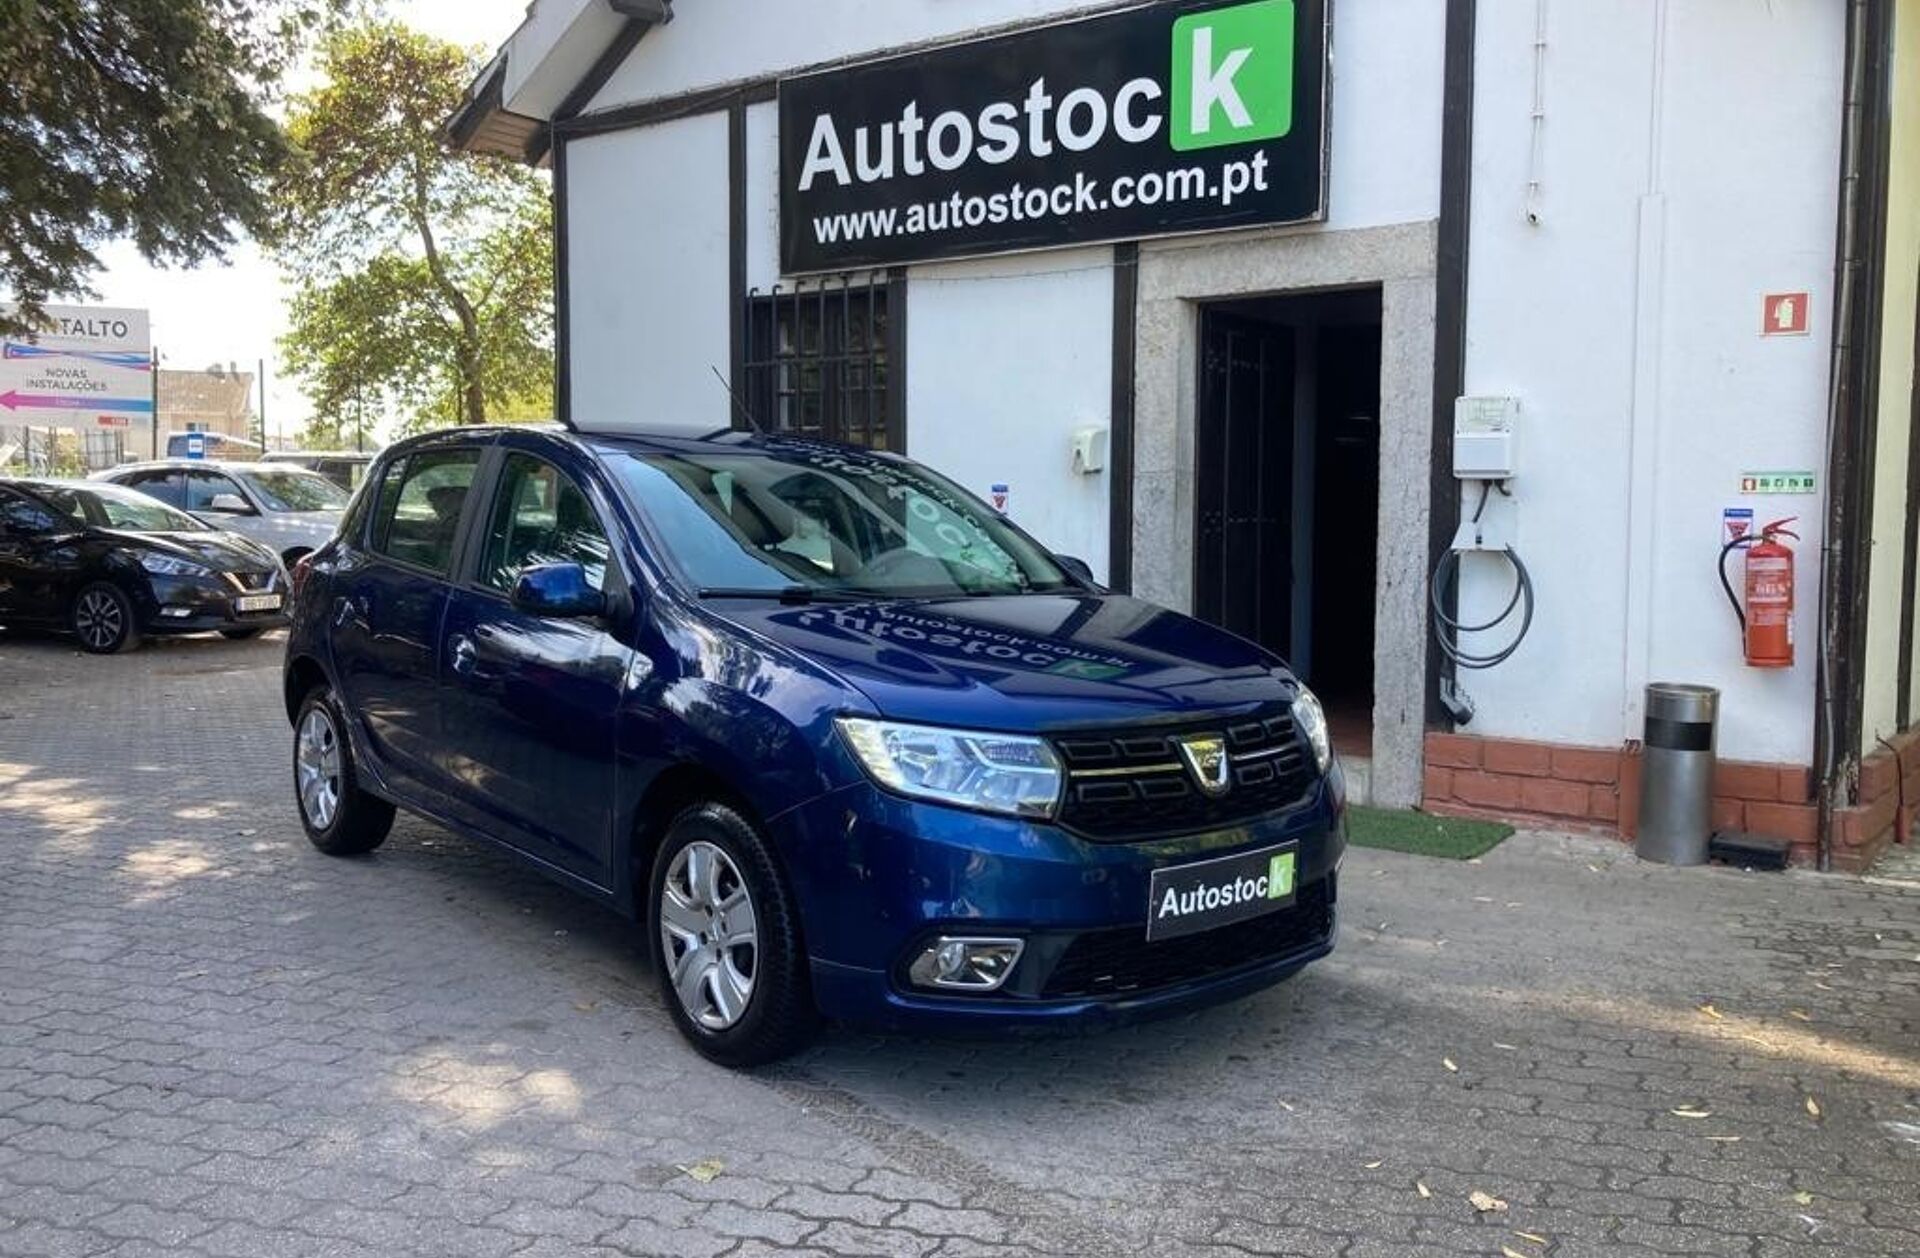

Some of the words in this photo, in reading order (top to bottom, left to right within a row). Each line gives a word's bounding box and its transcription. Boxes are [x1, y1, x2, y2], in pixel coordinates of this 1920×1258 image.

[799, 26, 1255, 191] Autostock
[813, 150, 1269, 243] www.autostock.com.pt
[46, 367, 87, 378] NOVAS
[1158, 858, 1287, 918] Autostock
